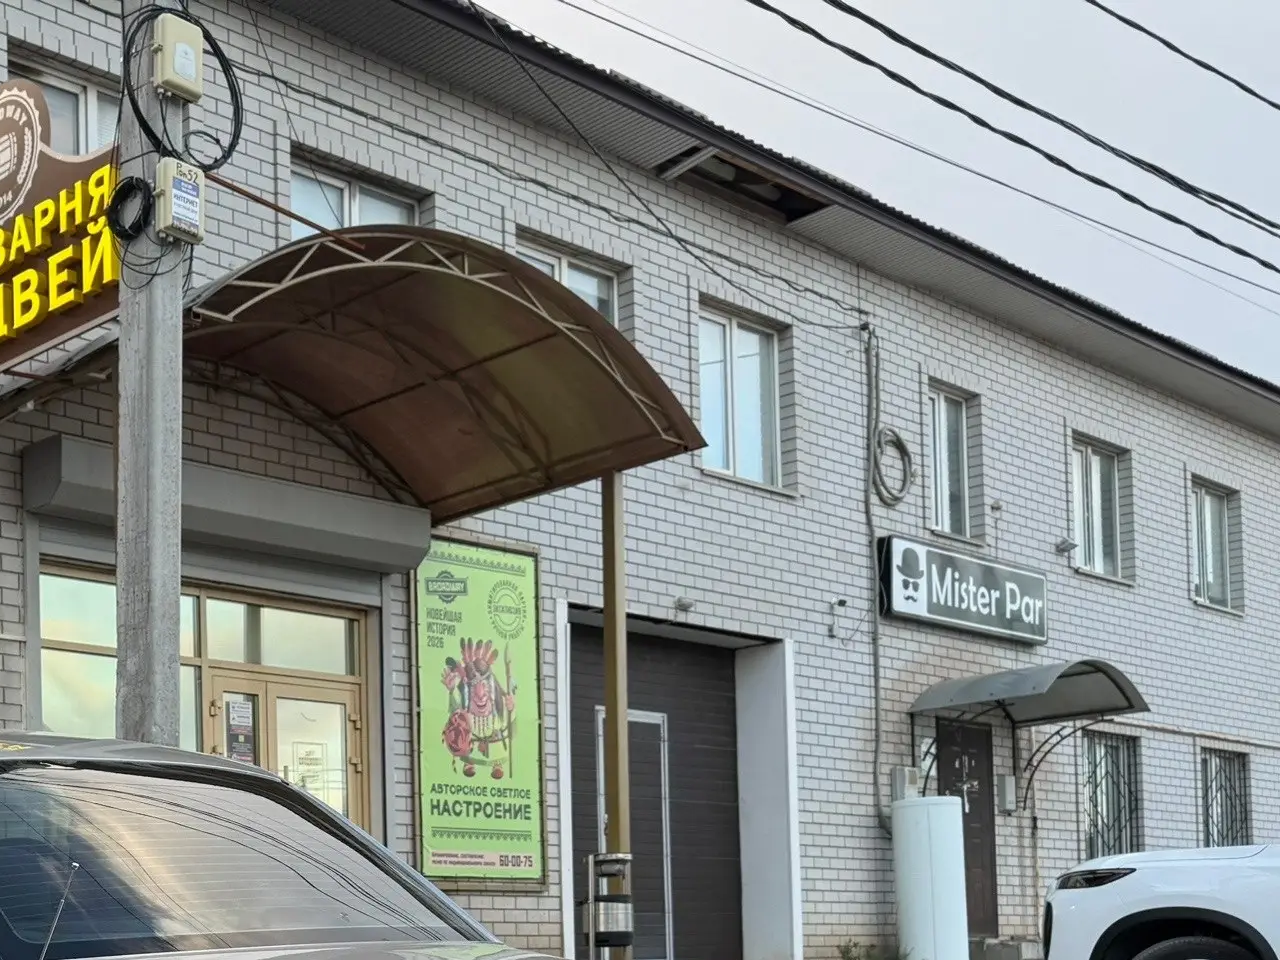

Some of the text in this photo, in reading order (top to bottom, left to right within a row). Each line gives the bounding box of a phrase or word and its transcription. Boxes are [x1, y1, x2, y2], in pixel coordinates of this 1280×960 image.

[931, 563, 1043, 625] Mister Par
[431, 783, 531, 800] АВТОРСКОЕ СВЕТЛОЕ
[430, 798, 532, 821] НАСТРОЕНИЕ
[499, 854, 533, 868] 60-00-75
